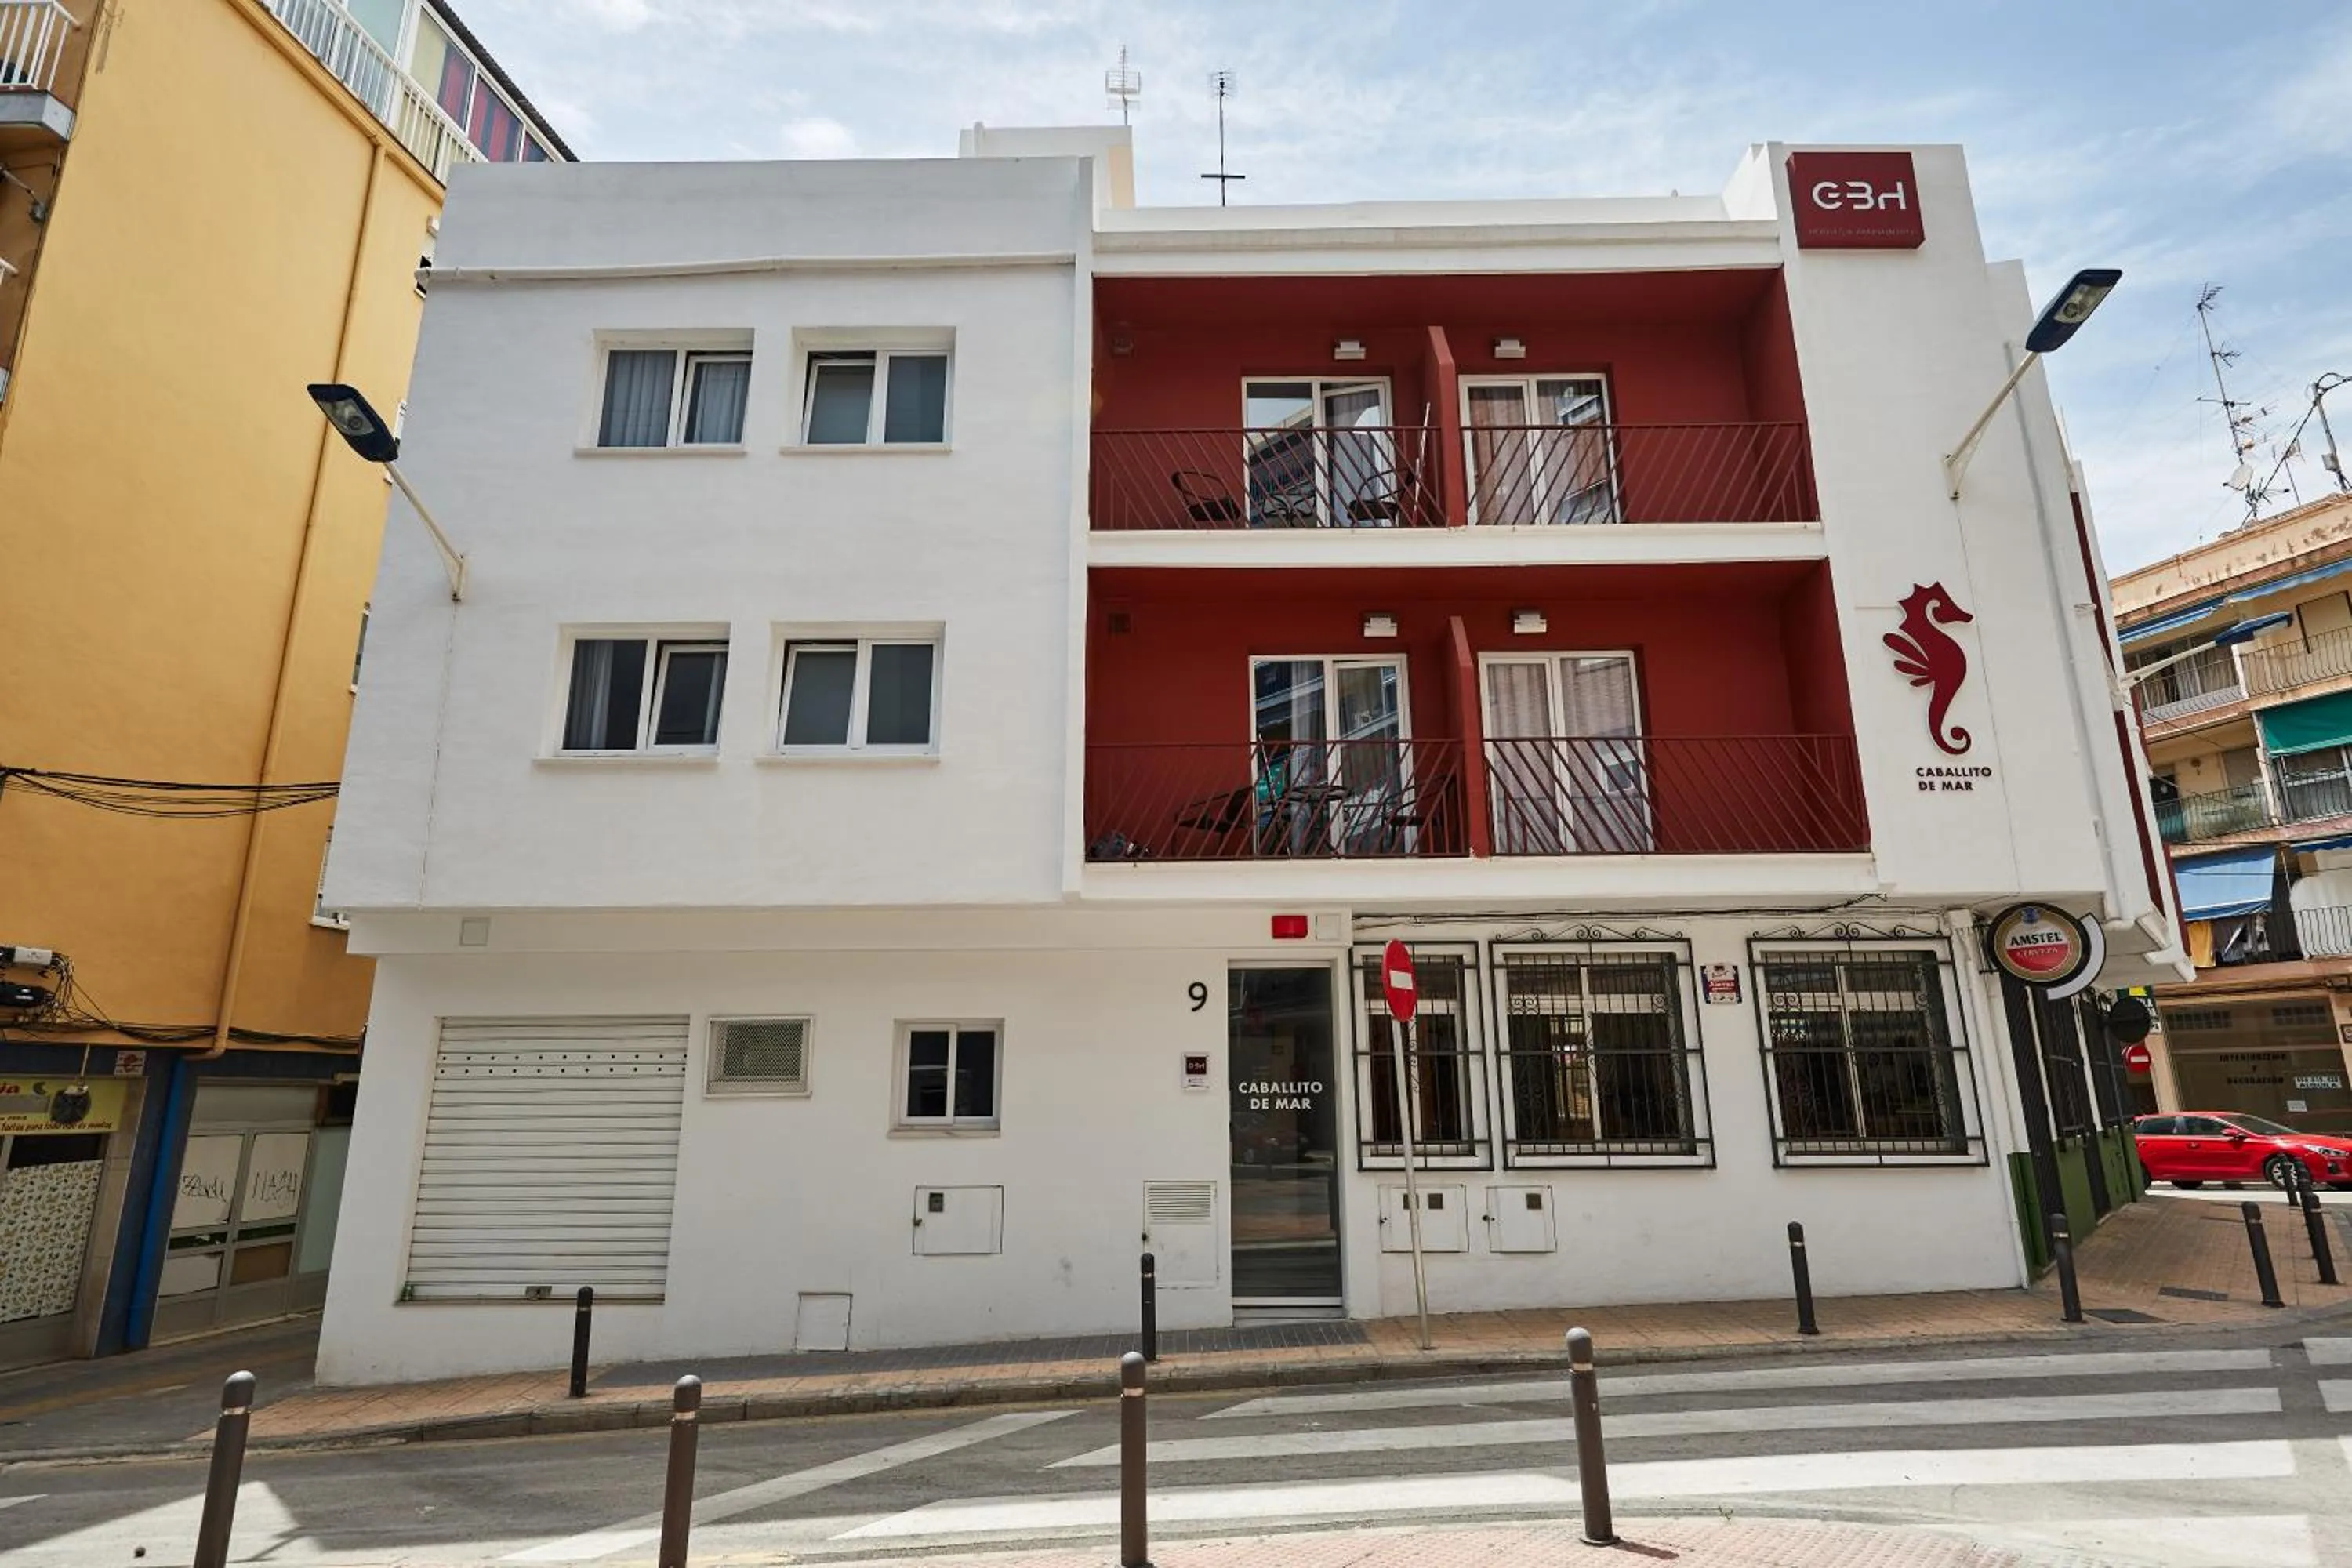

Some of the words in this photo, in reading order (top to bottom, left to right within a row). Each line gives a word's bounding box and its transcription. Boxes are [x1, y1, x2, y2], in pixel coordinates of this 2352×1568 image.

[1812, 181, 1907, 210] GBH
[1915, 767, 1992, 777] CABALLITO
[1918, 781, 1936, 791] DE
[1942, 781, 1974, 791] MAR
[2009, 932, 2063, 946] AMSTEL
[1188, 982, 1208, 1012] 9
[1238, 1081, 1323, 1094] CABALLITO
[1250, 1098, 1269, 1109] DE
[1275, 1098, 1312, 1109] MAR
